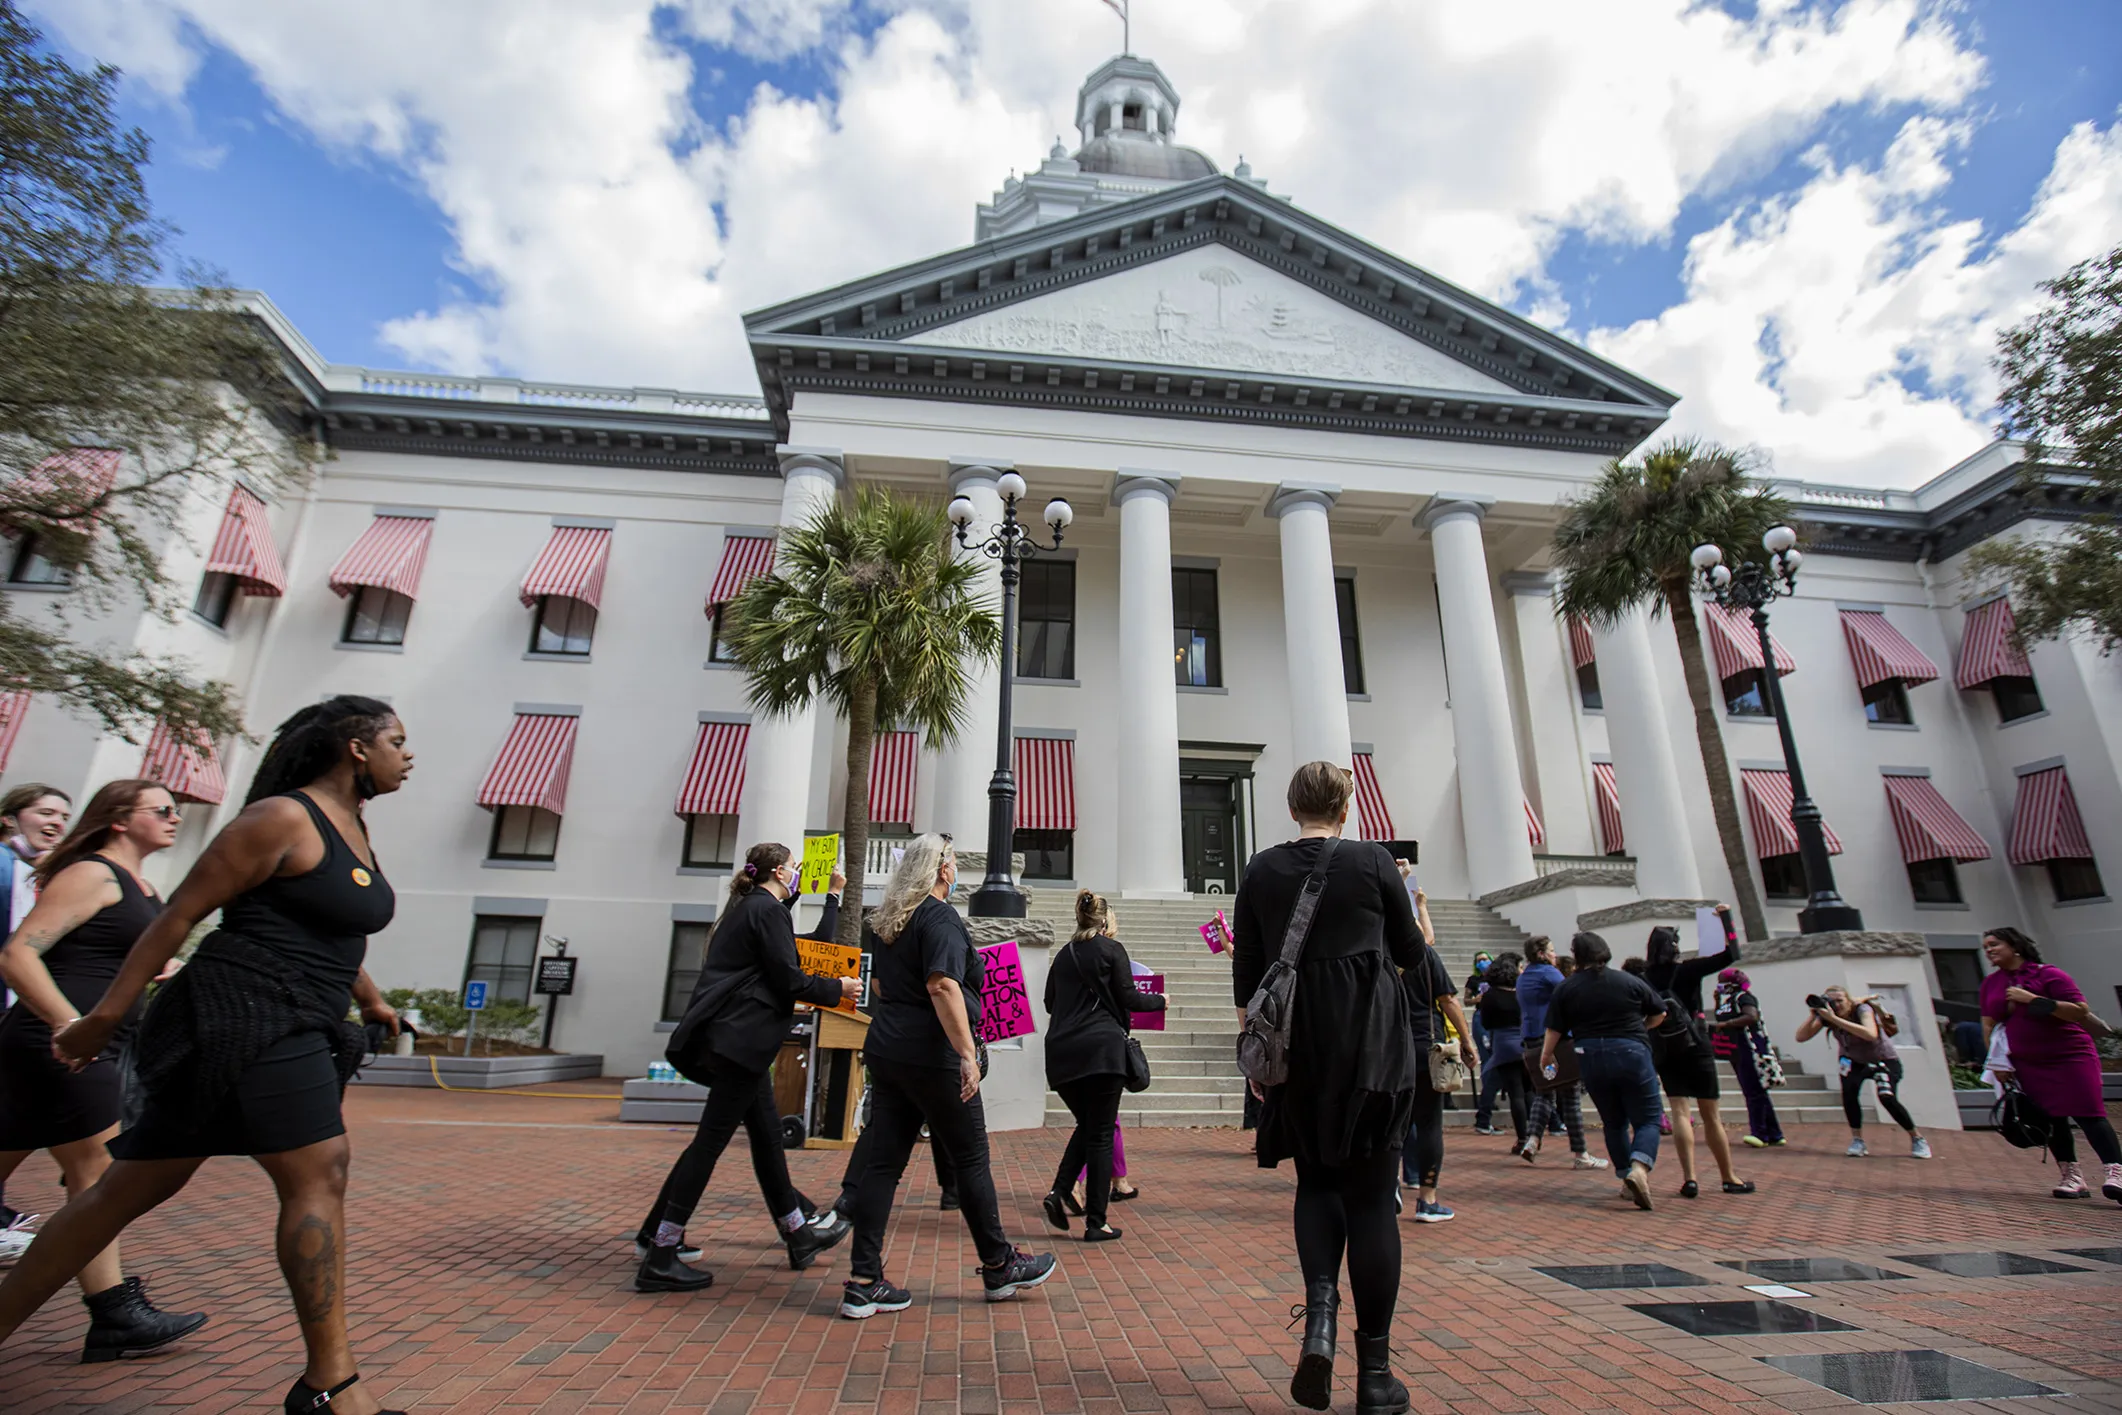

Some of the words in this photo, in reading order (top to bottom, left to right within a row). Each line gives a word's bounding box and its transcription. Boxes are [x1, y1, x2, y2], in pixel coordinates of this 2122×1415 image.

[809, 943, 840, 958] UTERUS
[979, 947, 1001, 966] DY
[800, 956, 830, 971] OULDN'T
[833, 961, 844, 974] BE
[984, 964, 1018, 989] ICE
[980, 983, 1026, 1009] TION
[1011, 1002, 1025, 1019] &
